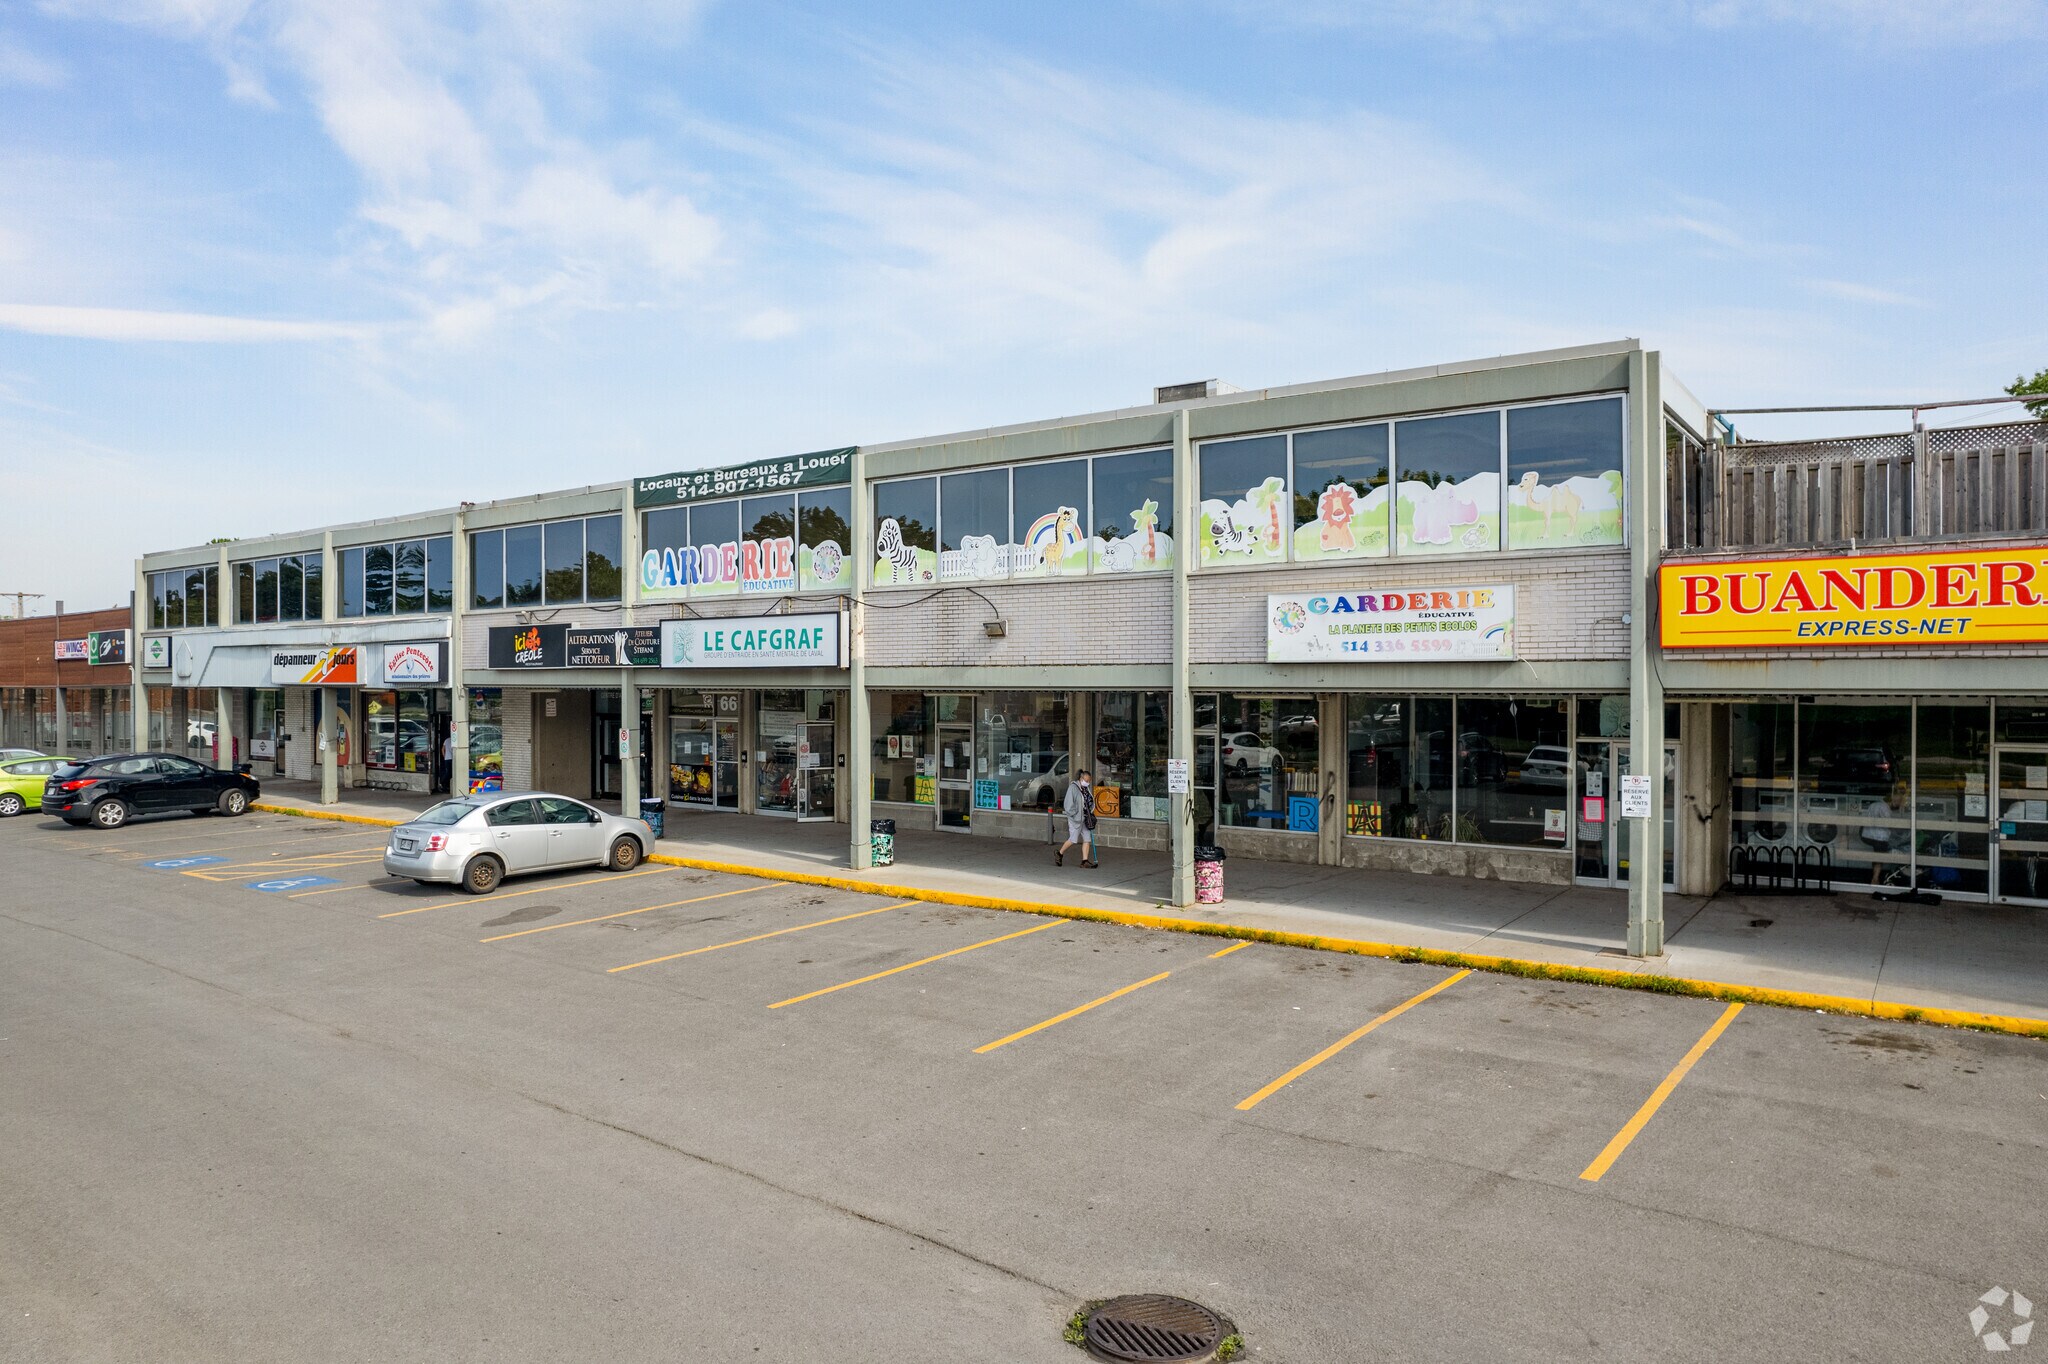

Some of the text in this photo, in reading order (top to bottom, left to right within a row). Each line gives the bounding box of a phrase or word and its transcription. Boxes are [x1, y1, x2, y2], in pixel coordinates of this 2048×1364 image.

[640, 453, 848, 492] Locaux et Bureaux a Louer
[676, 471, 804, 499] 514-907-1567
[643, 540, 792, 587] GARDERIE
[743, 578, 794, 591] ÉDUCATIVE
[1679, 561, 2048, 616] BUANDER
[1307, 589, 1496, 615] GARDERIE
[1418, 611, 1475, 619] ÉDUCATIVE
[1328, 620, 1478, 635] LA PLANETE DES PETITS ECOLOS
[1796, 617, 1972, 638] EXPRESS-NET
[66, 641, 82, 653] WINGS
[514, 632, 526, 652] ici
[569, 635, 615, 645] ALTERATIONS
[634, 638, 660, 646] COUTURE
[704, 627, 824, 651] LE CAFGRAF
[1340, 639, 1452, 652] 514 336 5599
[273, 652, 317, 668] dépanneur
[332, 652, 355, 668] jours
[572, 655, 611, 665] NETTOYEUR
[724, 651, 751, 659] D'ENTRAIDE
[760, 650, 776, 658] SANTÉ
[777, 650, 799, 658] MENTALE
[719, 695, 738, 712] 66
[1095, 788, 1119, 814] G
[1293, 800, 1317, 831] R
